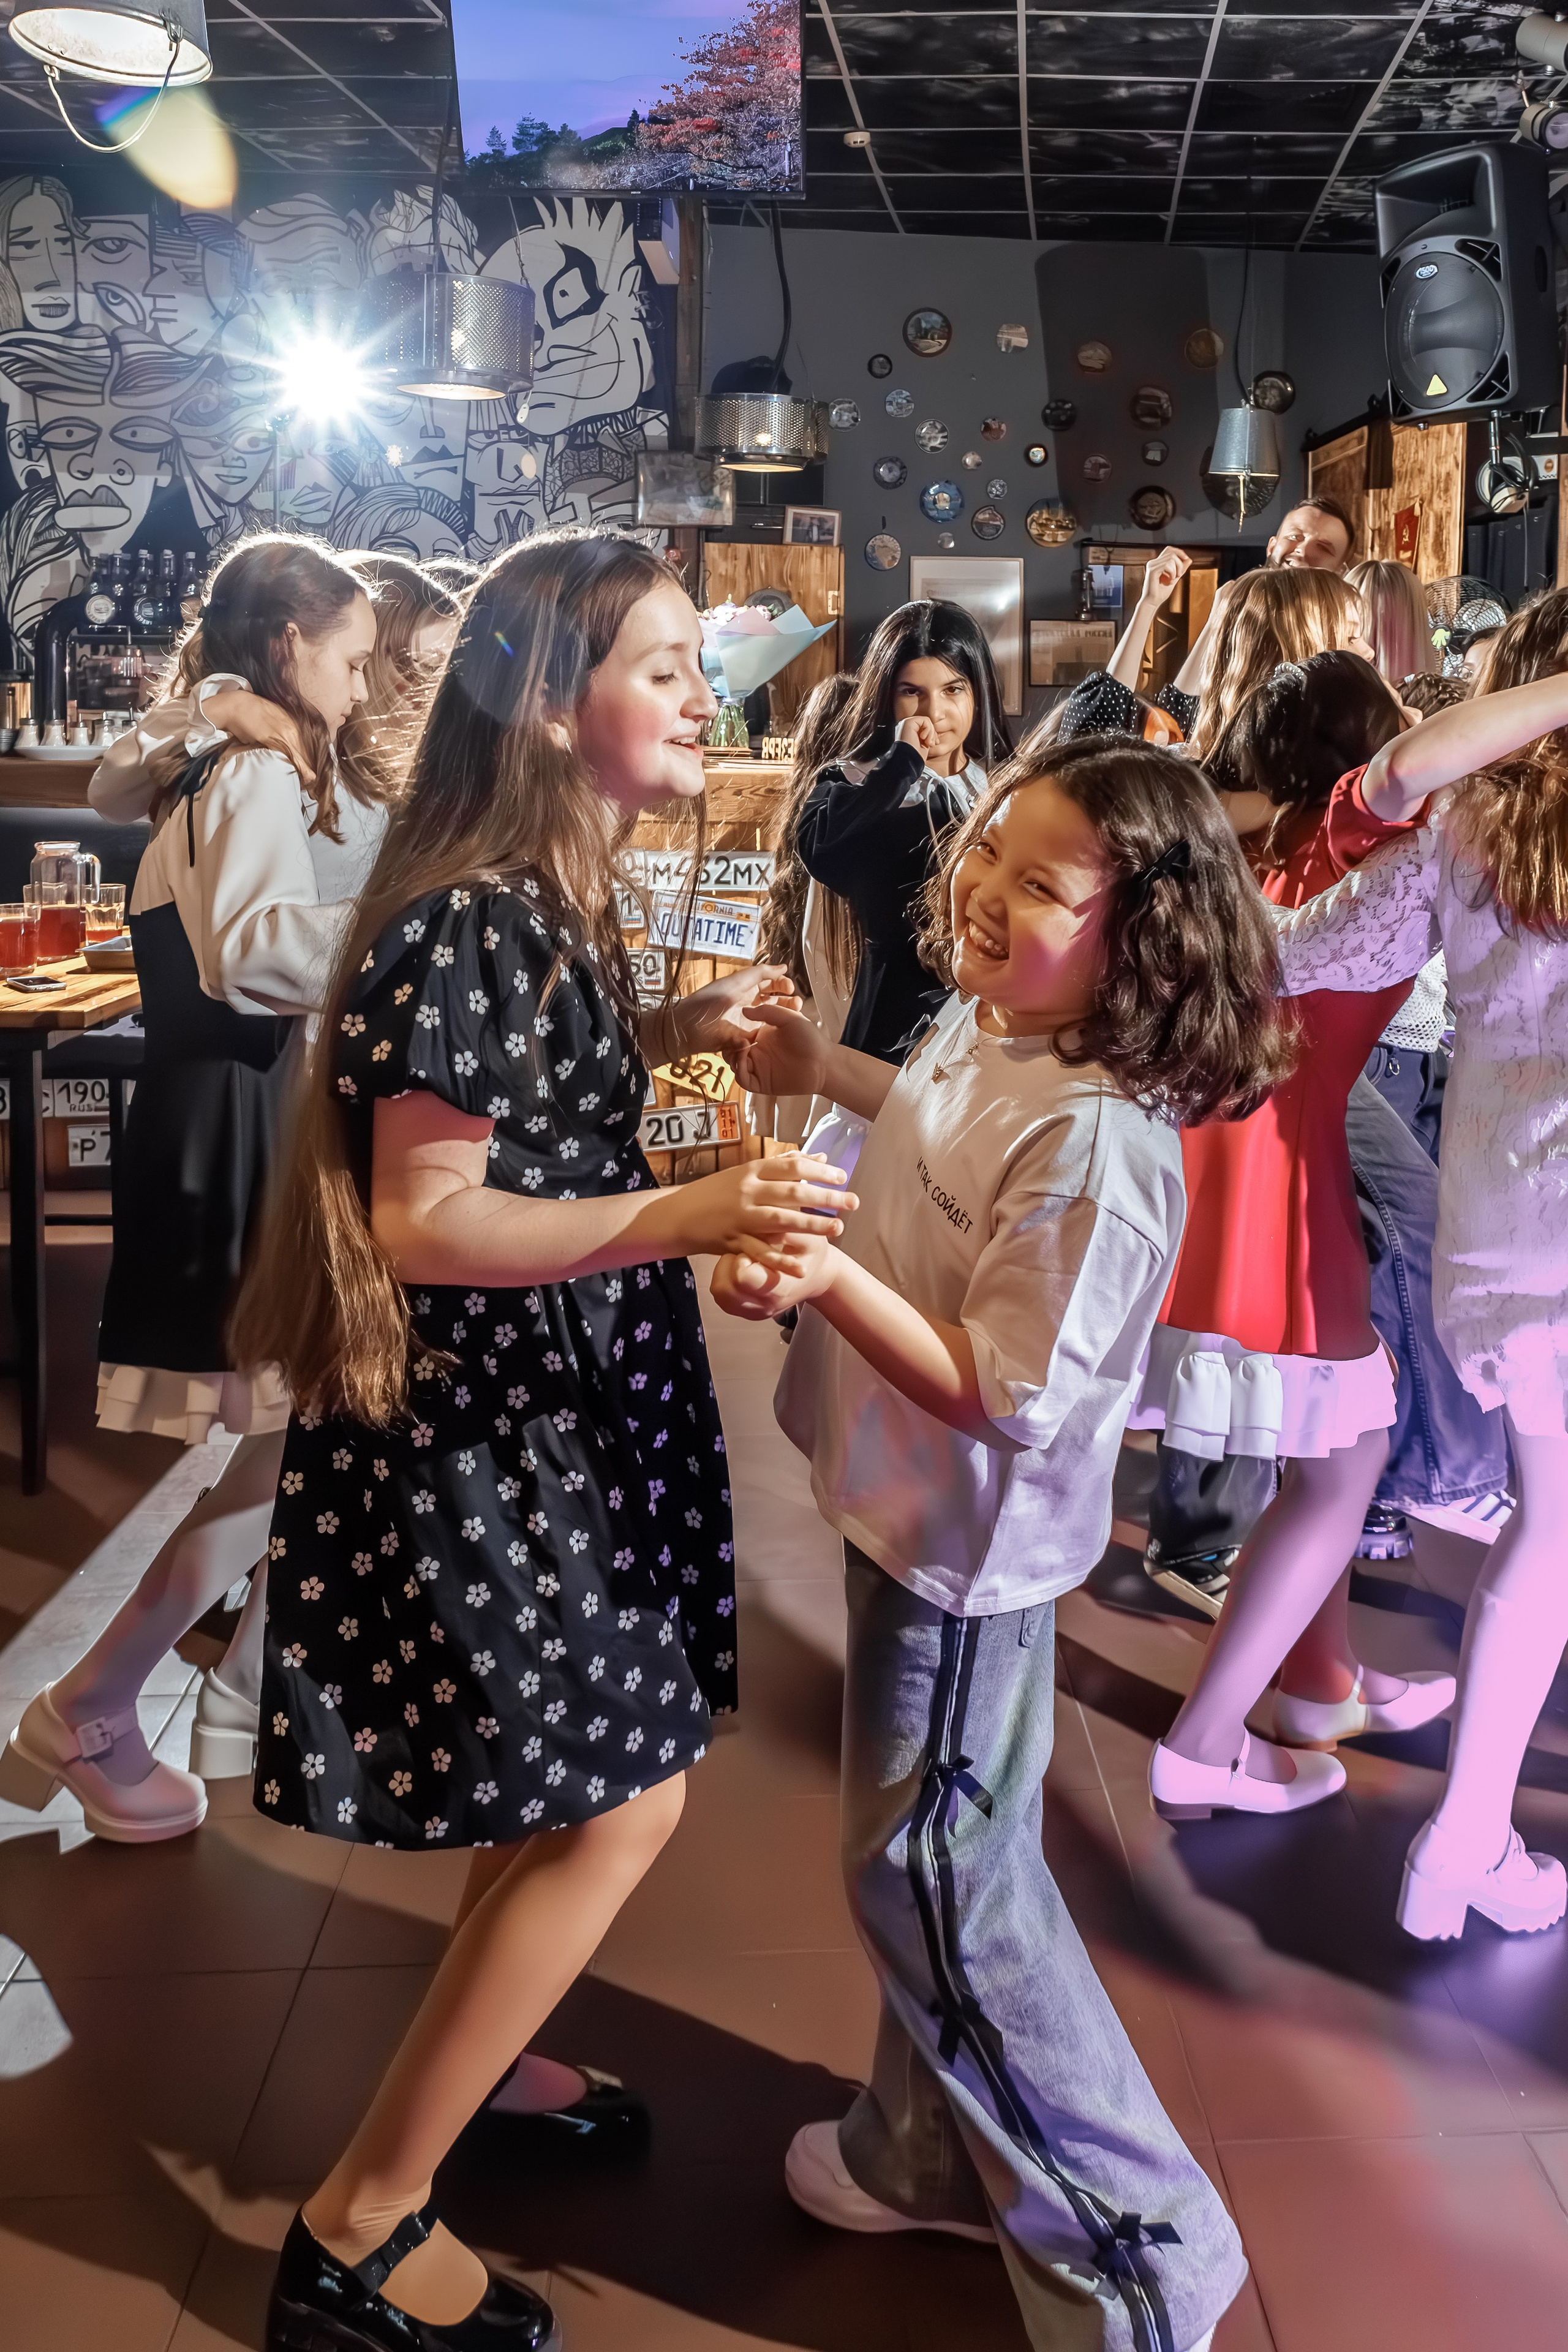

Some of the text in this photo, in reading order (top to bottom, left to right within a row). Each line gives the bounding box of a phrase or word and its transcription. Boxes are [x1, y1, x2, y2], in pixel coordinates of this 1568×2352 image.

[661, 912, 748, 948] OUATIME
[57, 1080, 106, 1104] 190
[931, 1186, 973, 1234] СОЙДЁТ
